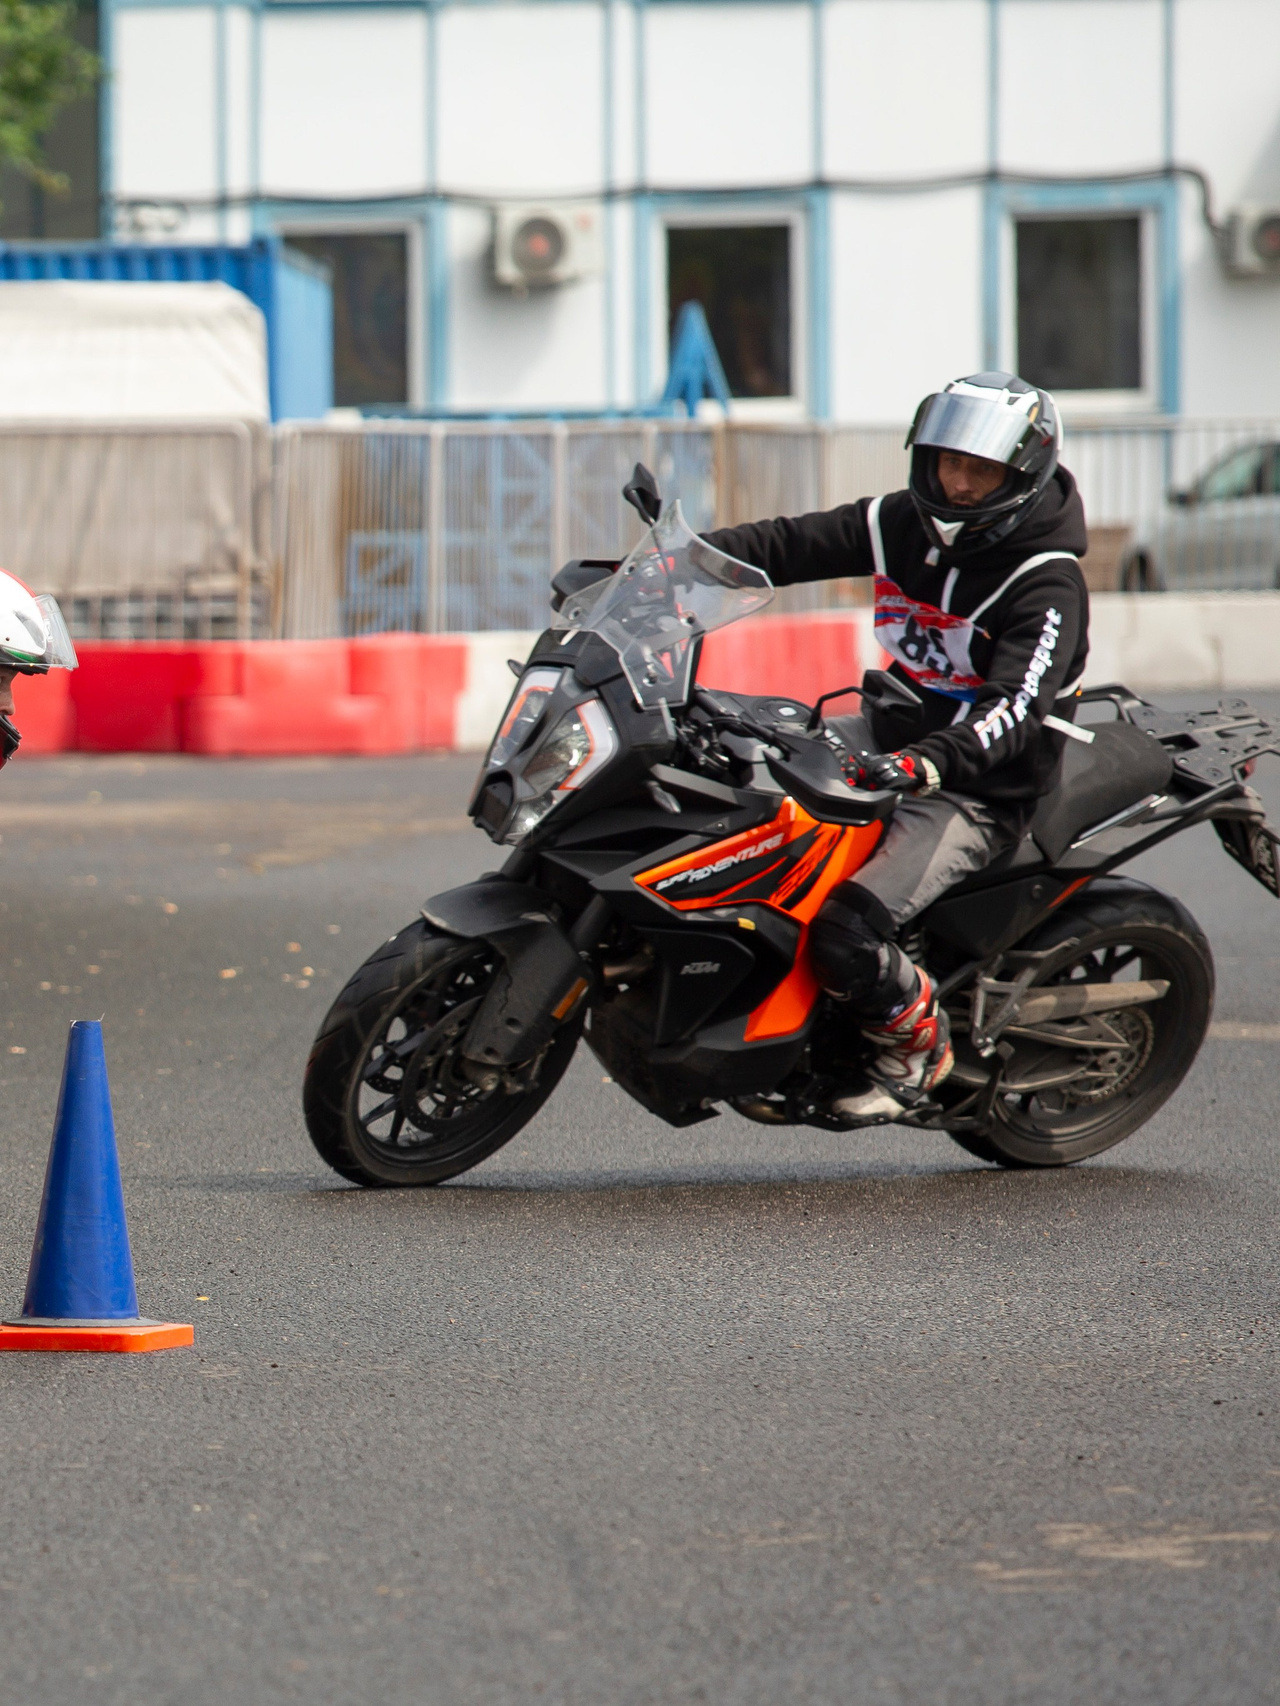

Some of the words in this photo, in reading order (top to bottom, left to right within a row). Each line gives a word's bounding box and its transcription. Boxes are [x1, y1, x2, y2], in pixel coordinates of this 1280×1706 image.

[1012, 607, 1063, 722] motosport
[687, 832, 786, 884] ADVENTURE
[680, 961, 721, 975] KTM
